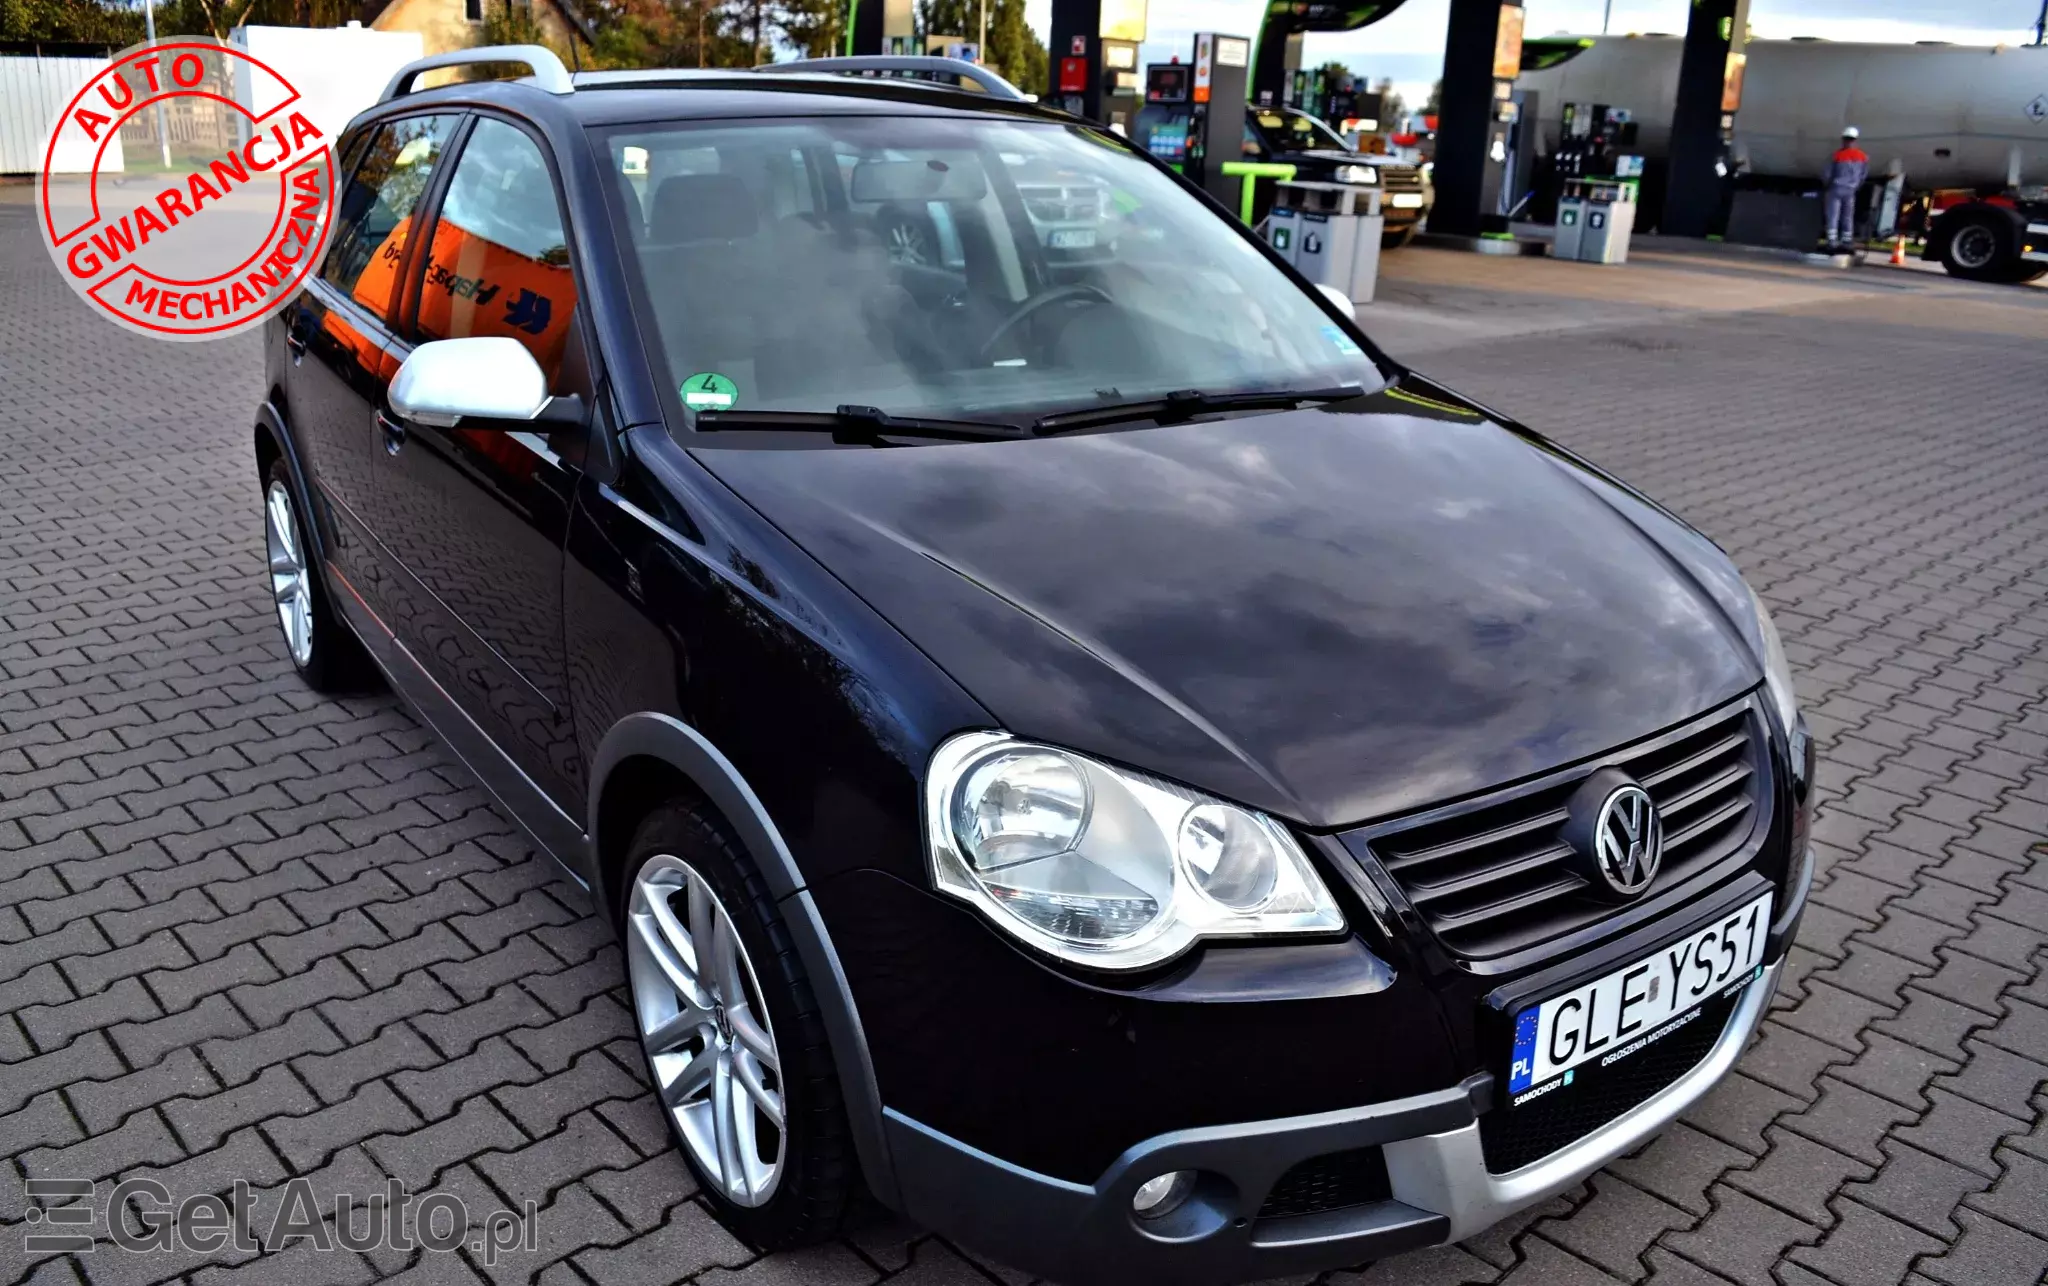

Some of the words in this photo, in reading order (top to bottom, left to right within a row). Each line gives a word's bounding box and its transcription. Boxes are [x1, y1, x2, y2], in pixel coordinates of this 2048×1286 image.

[701, 374, 718, 393] 4
[1549, 964, 1649, 1066] GLE
[1669, 903, 1760, 1012] YS51
[1511, 1057, 1531, 1081] PL
[1513, 1078, 1562, 1107] SAMOCHODY
